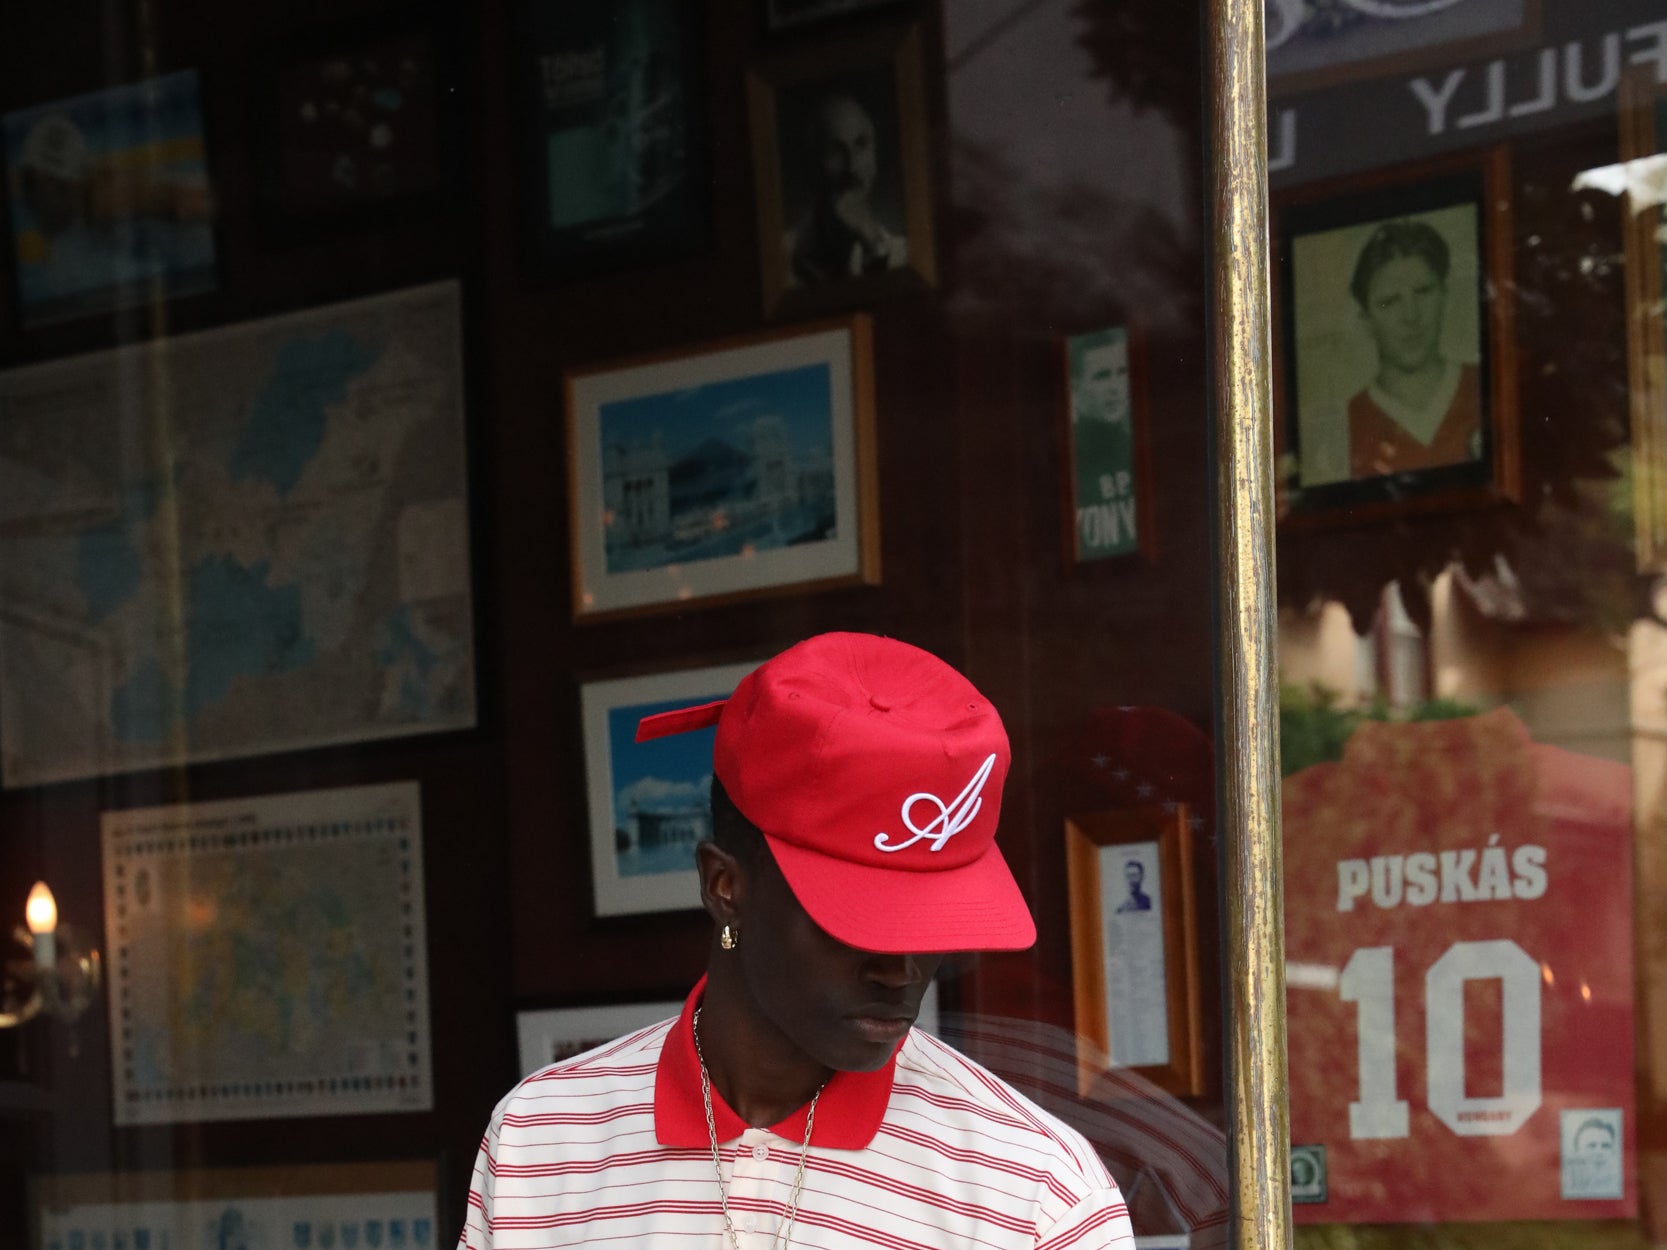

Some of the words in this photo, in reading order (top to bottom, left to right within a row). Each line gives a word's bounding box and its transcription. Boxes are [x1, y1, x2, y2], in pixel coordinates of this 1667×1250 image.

[874, 753, 996, 852] A
[1336, 833, 1547, 912] PUSKÁS
[1340, 939, 1542, 1139] 10
